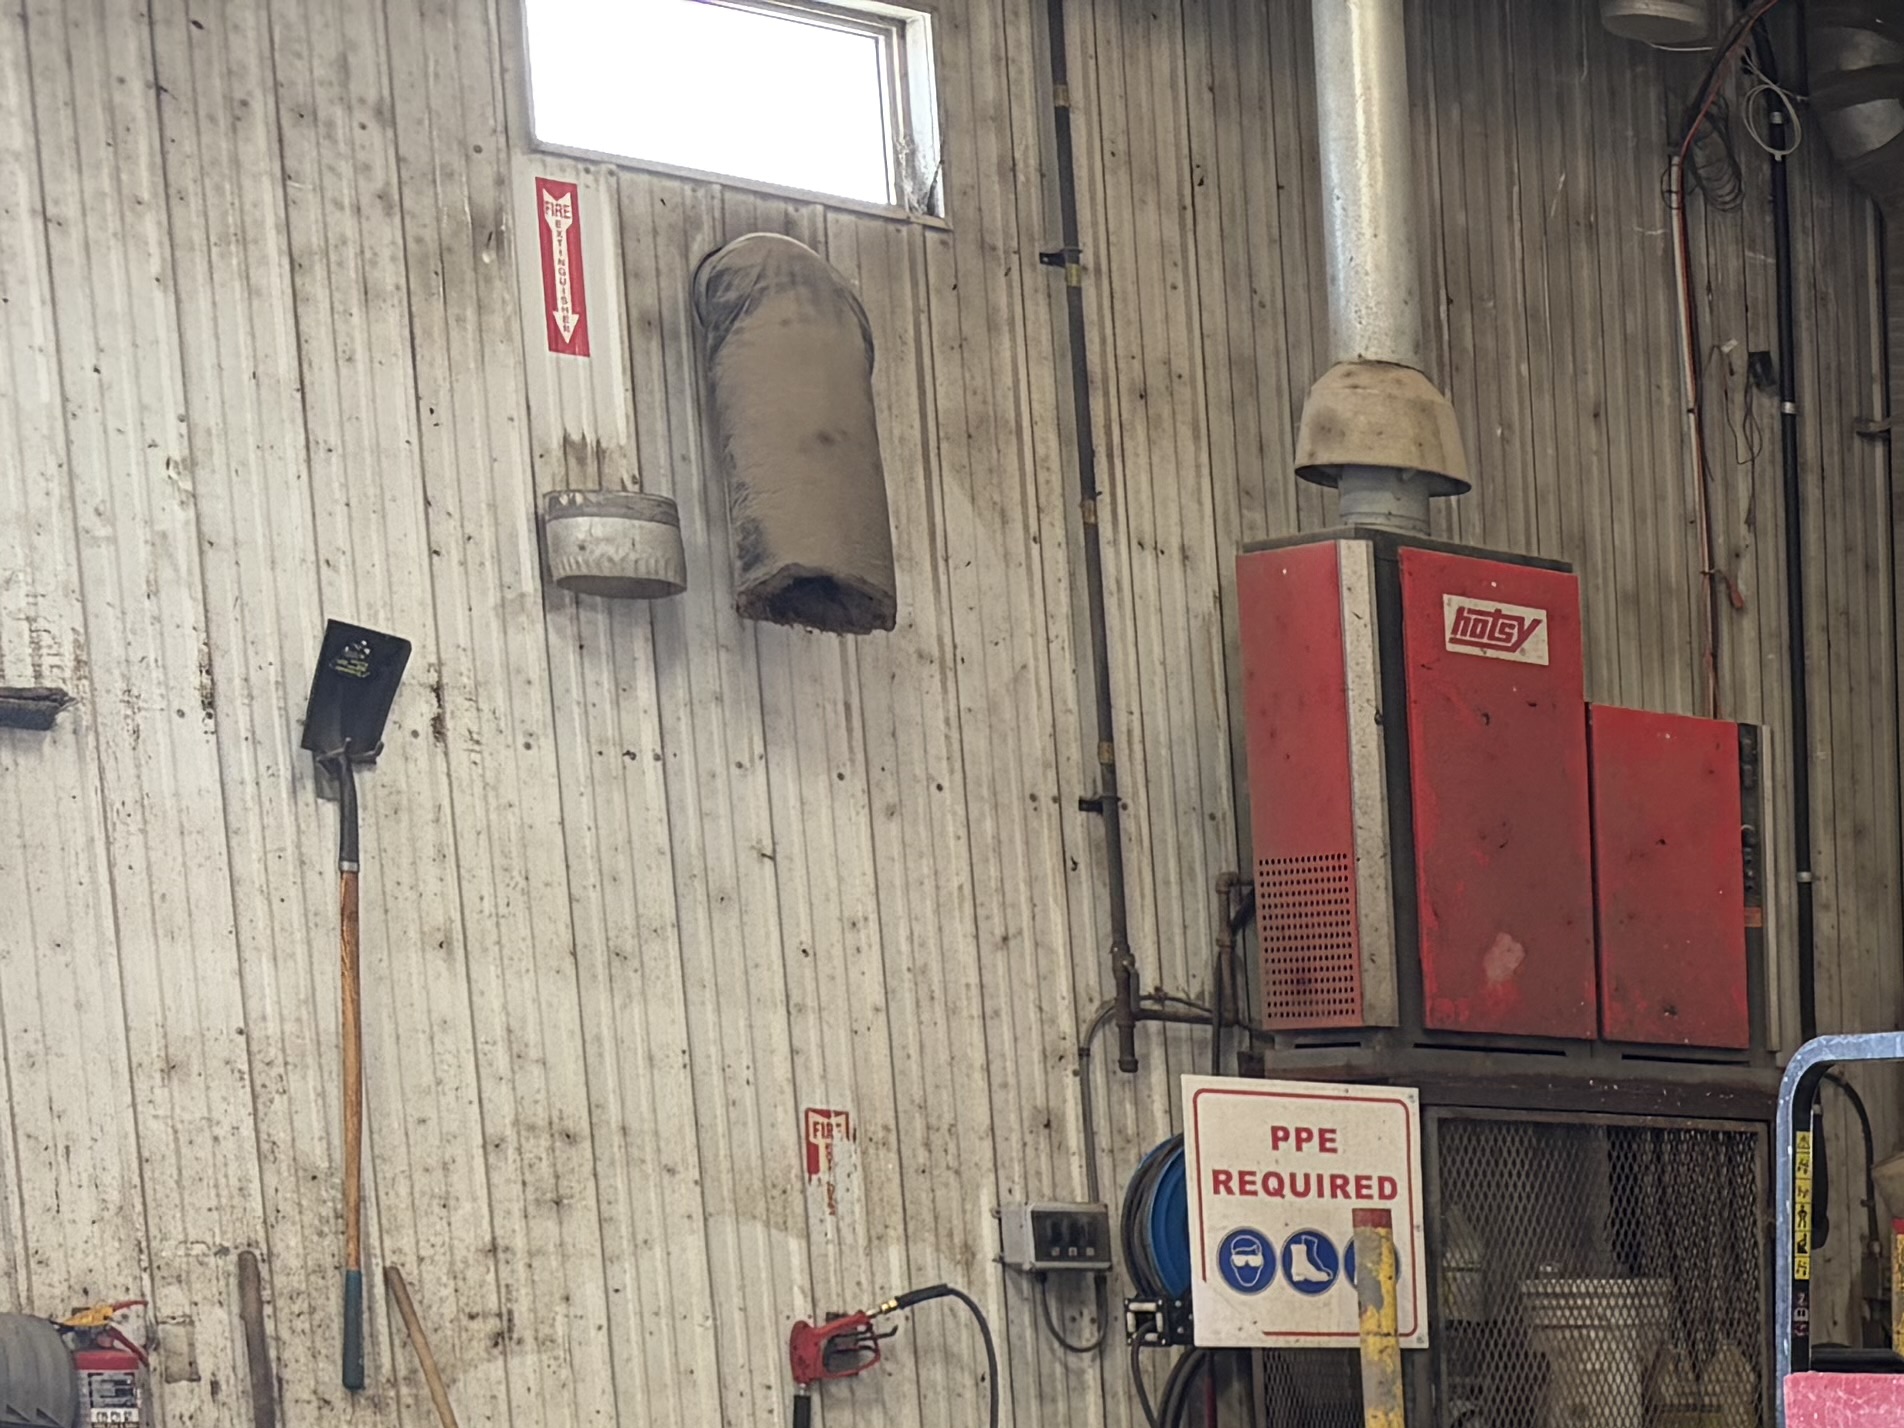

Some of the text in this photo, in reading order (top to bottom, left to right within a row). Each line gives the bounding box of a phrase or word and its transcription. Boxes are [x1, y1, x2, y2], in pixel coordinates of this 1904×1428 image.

[544, 200, 573, 220] FIRE
[554, 219, 571, 334] EXTINGUISHER
[1448, 605, 1544, 654] hotsy
[1270, 1125, 1339, 1154] PPE
[1211, 1169, 1399, 1202] REQUIRED
